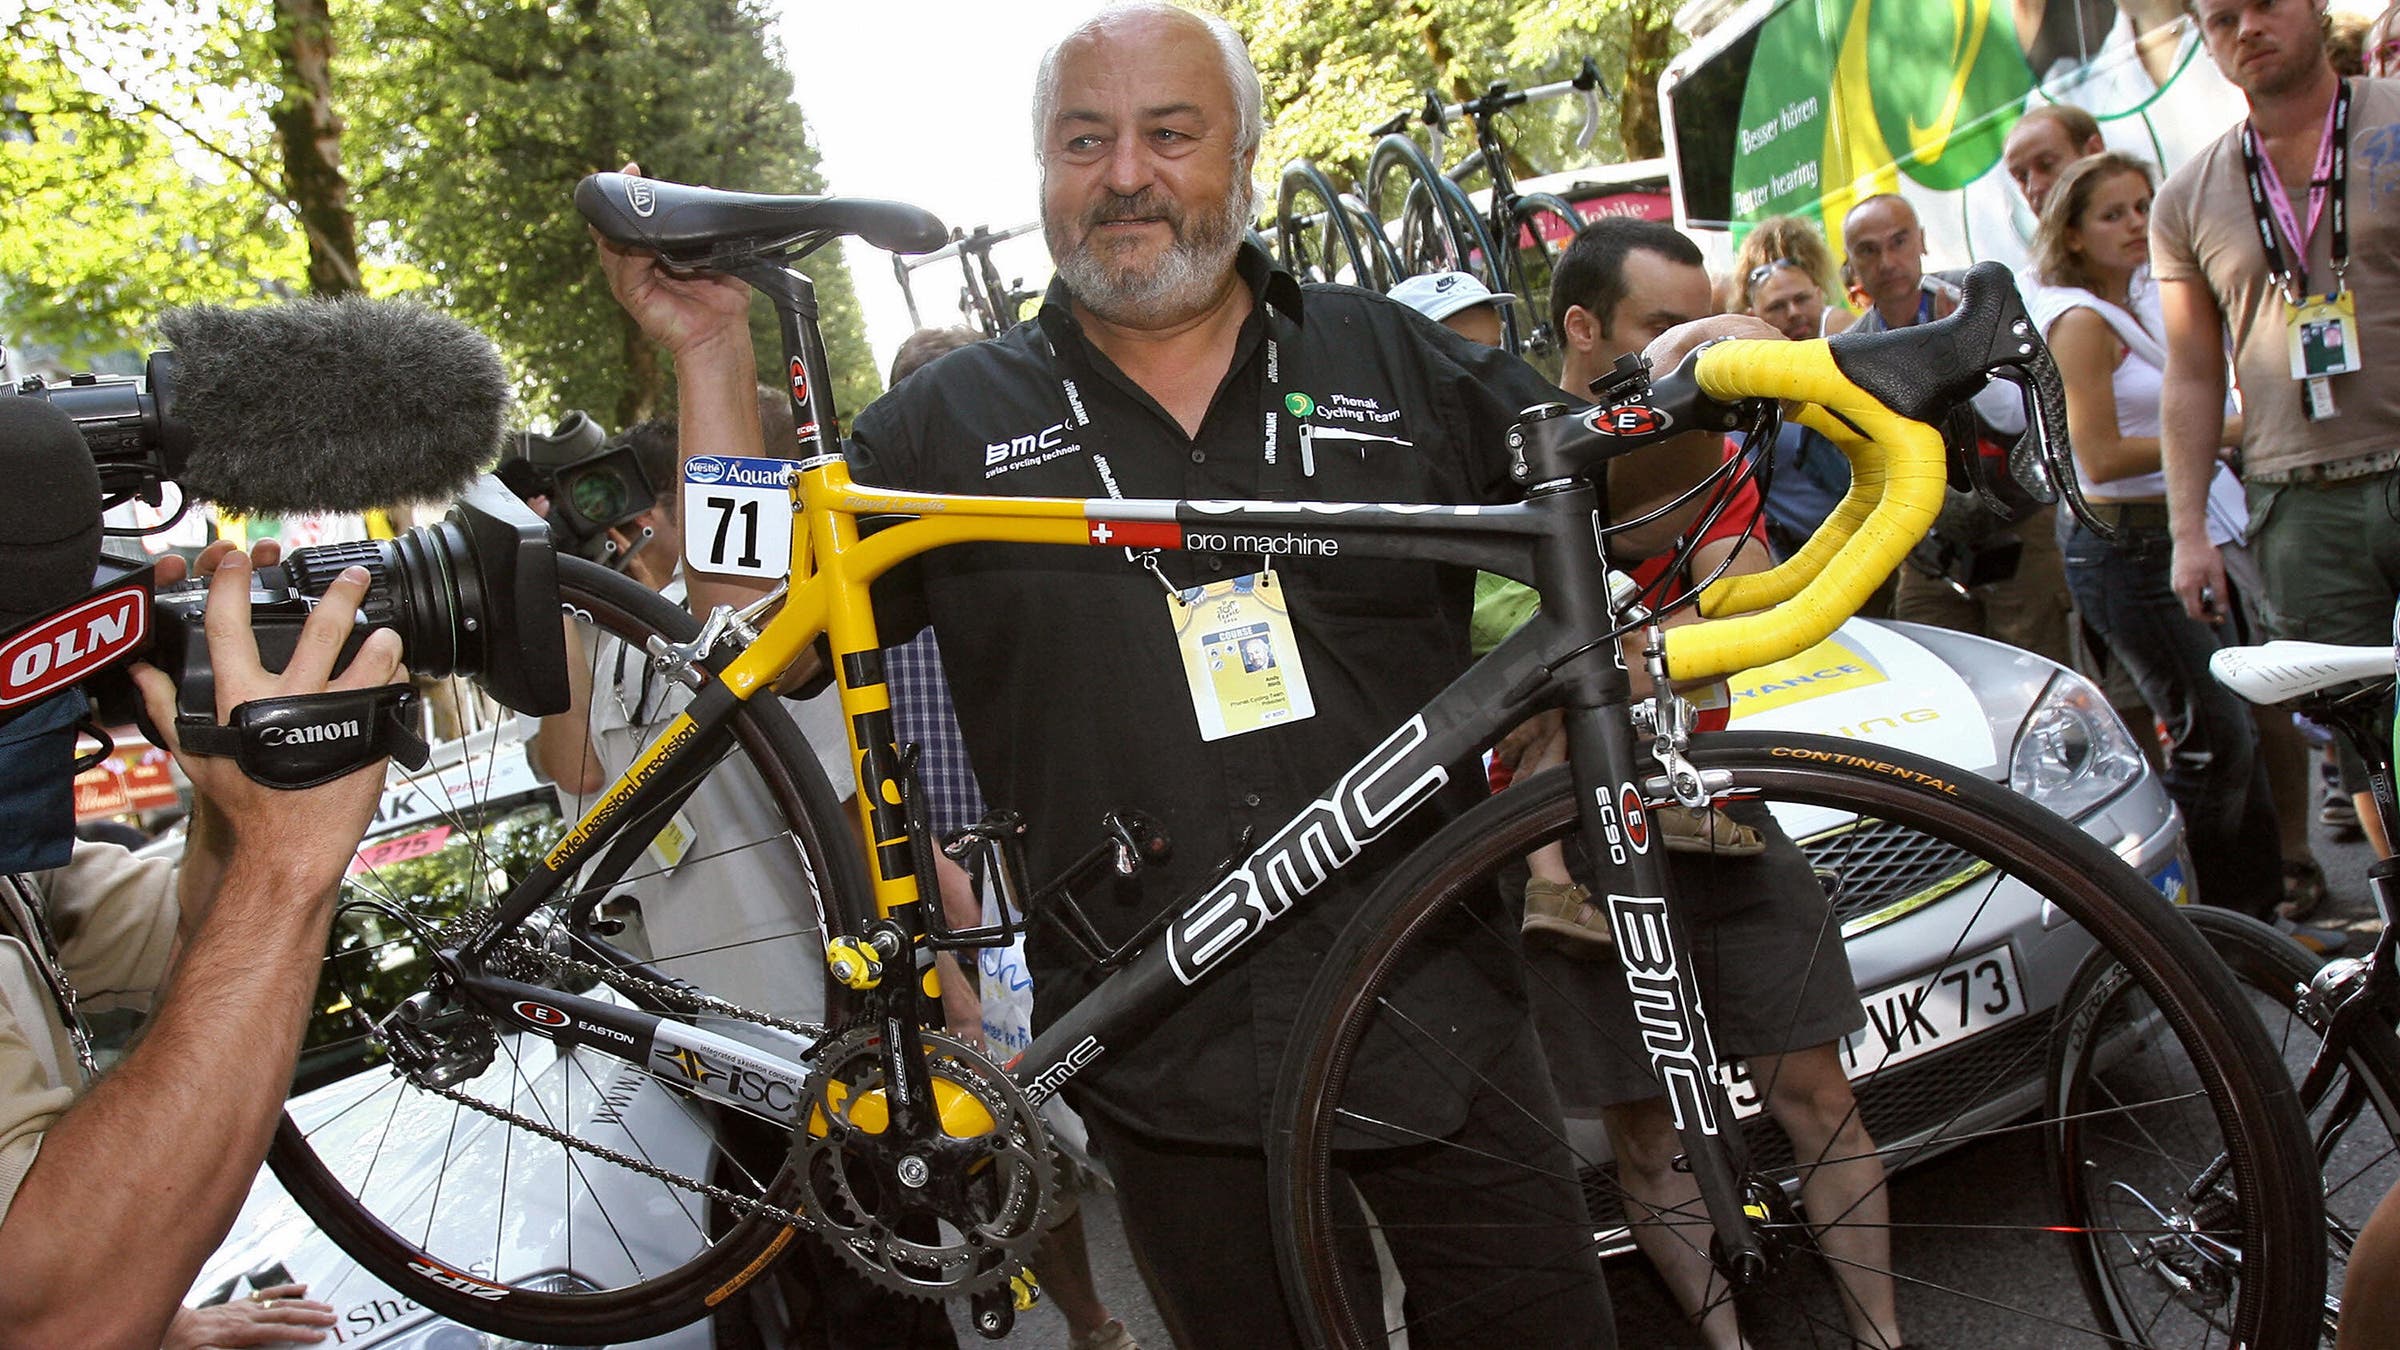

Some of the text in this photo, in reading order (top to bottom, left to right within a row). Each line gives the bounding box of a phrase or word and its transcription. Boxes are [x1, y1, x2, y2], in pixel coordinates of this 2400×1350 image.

[1741, 96, 1818, 155] Besser hören
[1733, 160, 1819, 217] Better hearing
[1316, 406, 1401, 423] Cycling Team
[1331, 394, 1379, 409] Phonak
[985, 424, 1063, 466] BMC
[985, 465, 1008, 479] swiss
[1009, 455, 1041, 471] cycling
[844, 496, 945, 512] Floyd Landis
[707, 496, 761, 568] 71
[1186, 532, 1338, 556] pro machine
[10, 604, 130, 687] OLN
[1219, 626, 1253, 641] COURSE
[260, 719, 360, 747] Canon
[635, 720, 700, 788] precision
[1771, 746, 1959, 796] CONTINENTAL
[582, 782, 639, 840] passion
[1595, 786, 1627, 865] EC90
[372, 836, 430, 866] 275
[550, 833, 584, 872] style
[1166, 712, 1449, 986] BMC
[1607, 894, 1718, 1136] BMC
[1867, 960, 2010, 1053] VK 73
[578, 1020, 635, 1045] EASTON
[700, 1044, 798, 1085] integrated skeleton concept
[727, 1065, 794, 1112] iSC
